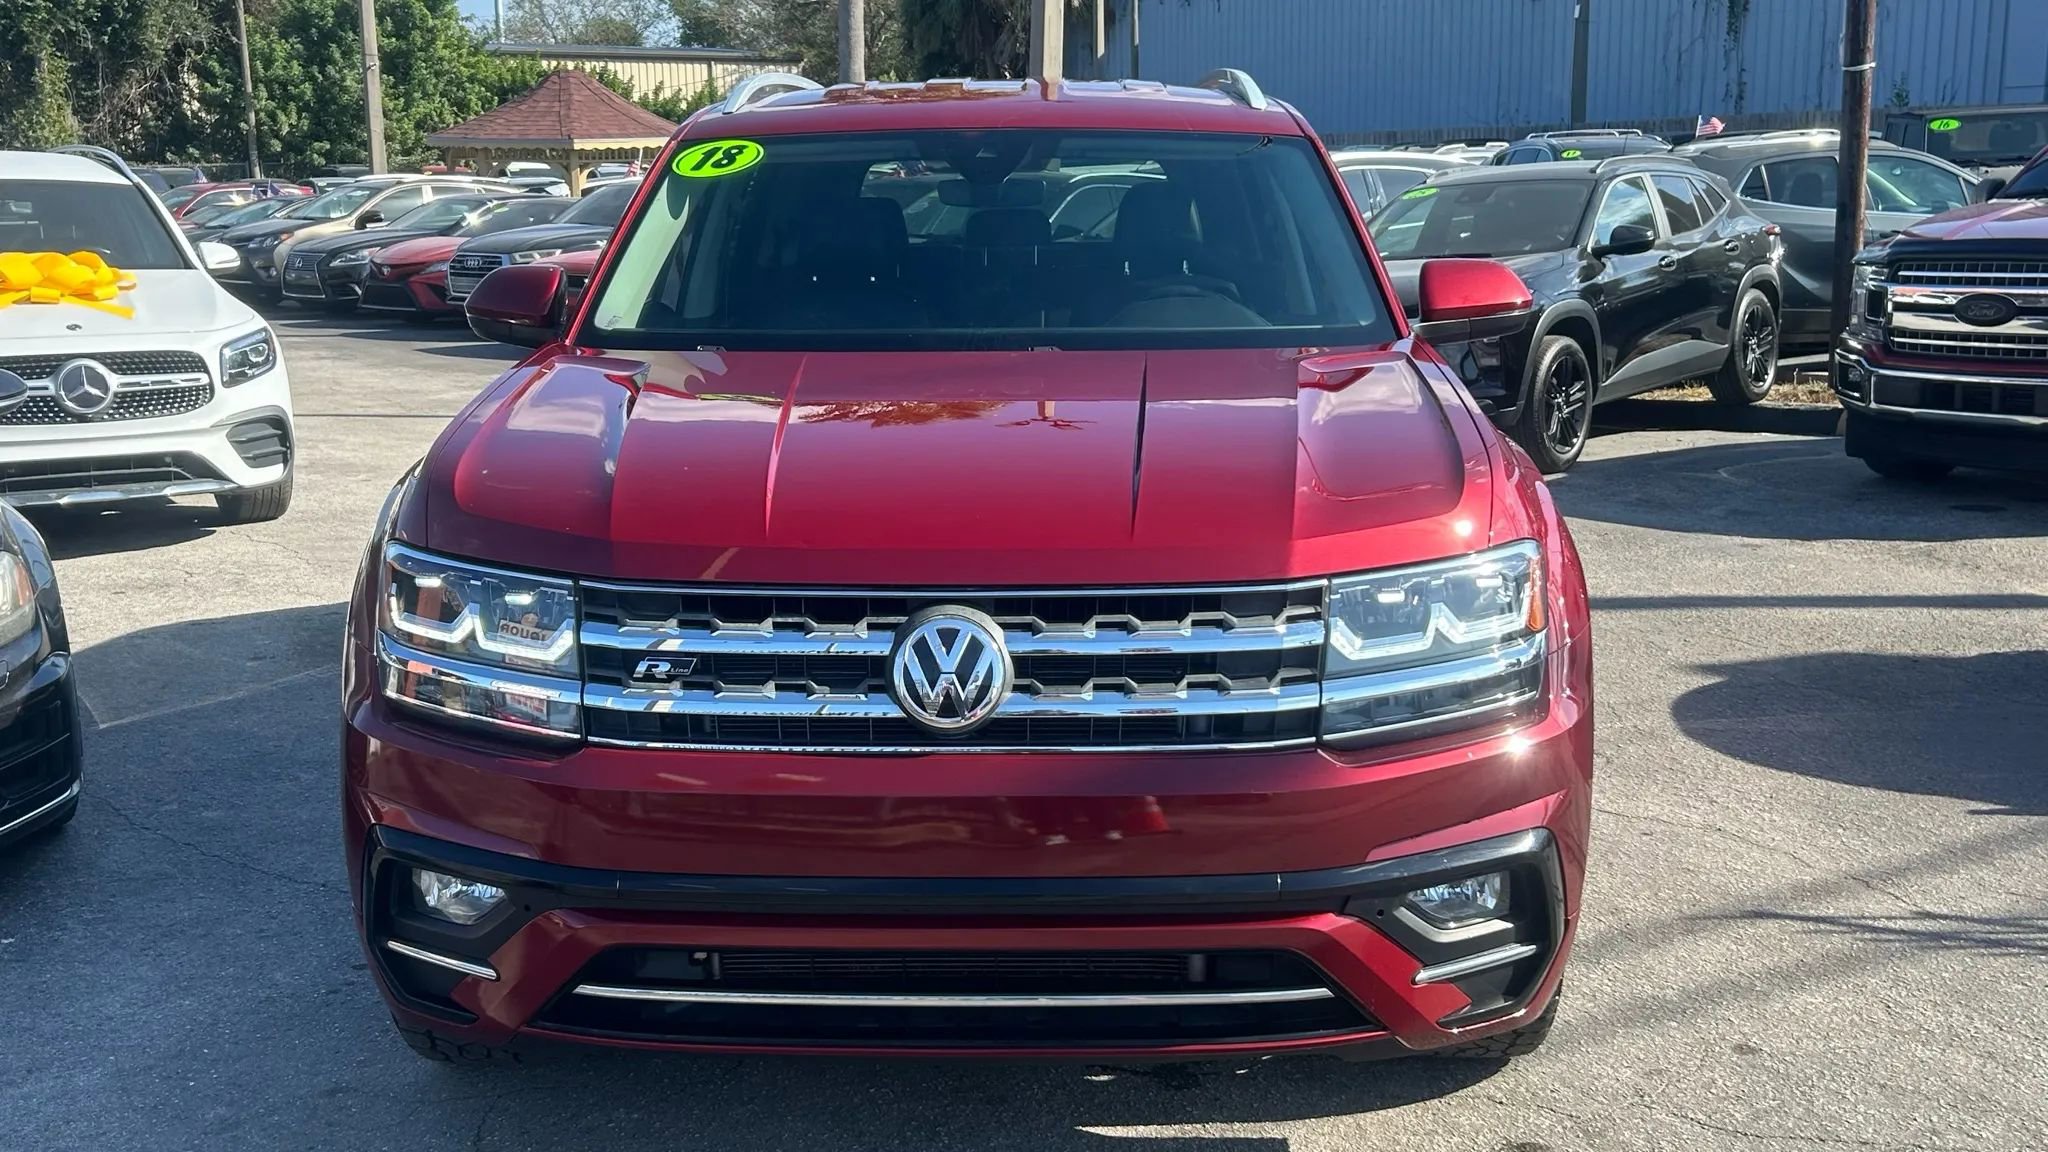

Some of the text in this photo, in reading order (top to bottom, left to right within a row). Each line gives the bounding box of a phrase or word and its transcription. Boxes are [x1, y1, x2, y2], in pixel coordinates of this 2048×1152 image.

[1937, 120, 1951, 129] 16
[689, 144, 749, 171] 18
[1967, 303, 1997, 317] Ford
[632, 660, 672, 679] R
[899, 620, 1000, 724] VW
